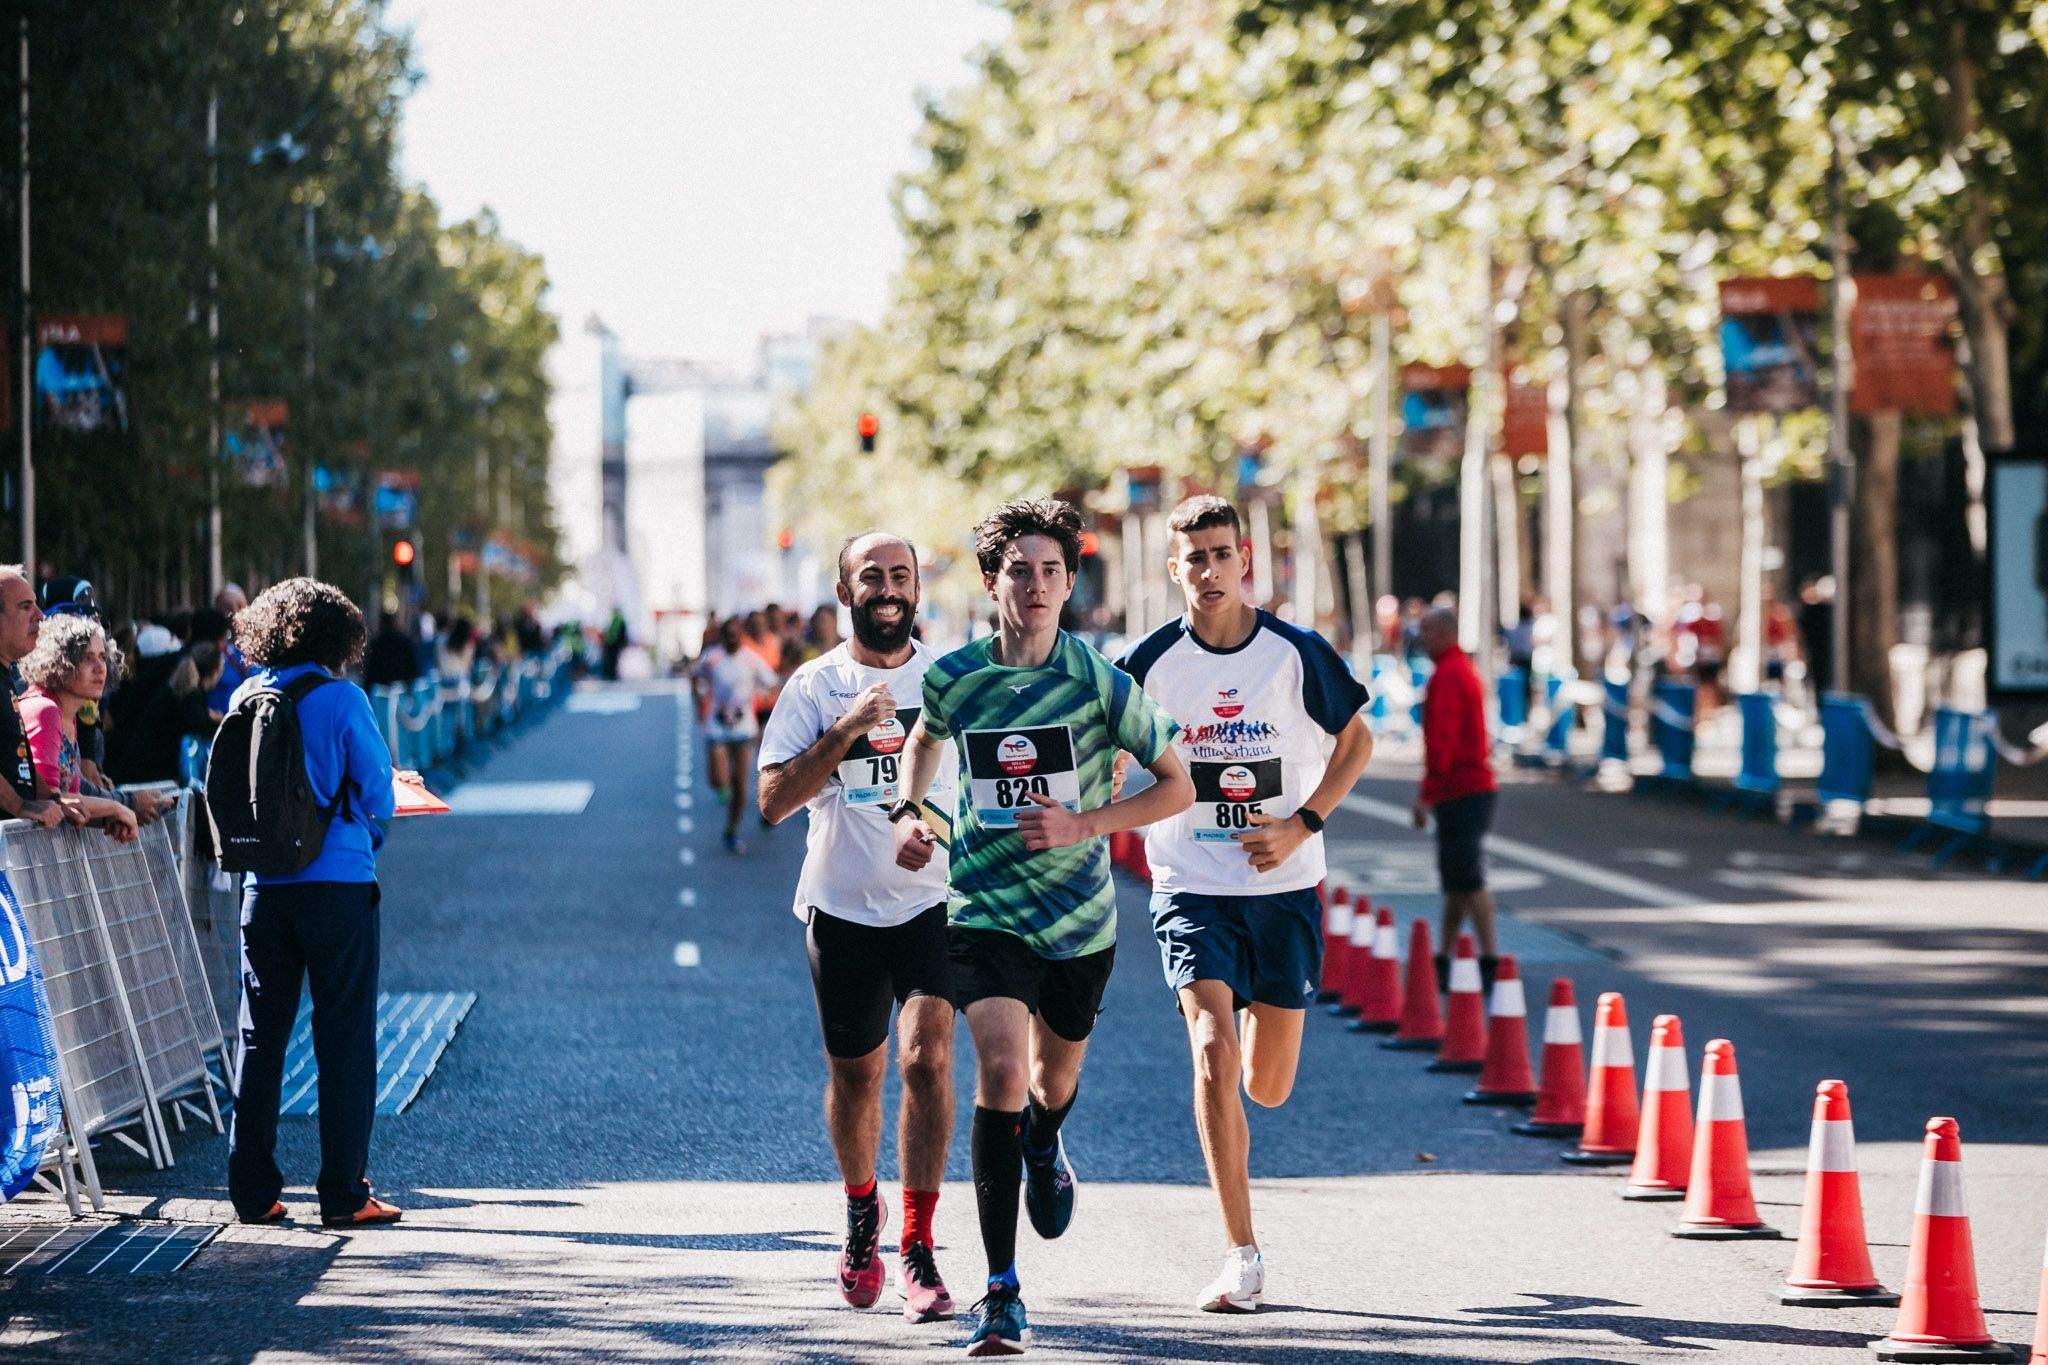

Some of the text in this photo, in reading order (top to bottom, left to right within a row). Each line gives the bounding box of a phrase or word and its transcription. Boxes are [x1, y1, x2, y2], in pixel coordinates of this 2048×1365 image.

[866, 755, 902, 785] 79
[996, 776, 1049, 808] 820
[1216, 803, 1263, 828] 805
